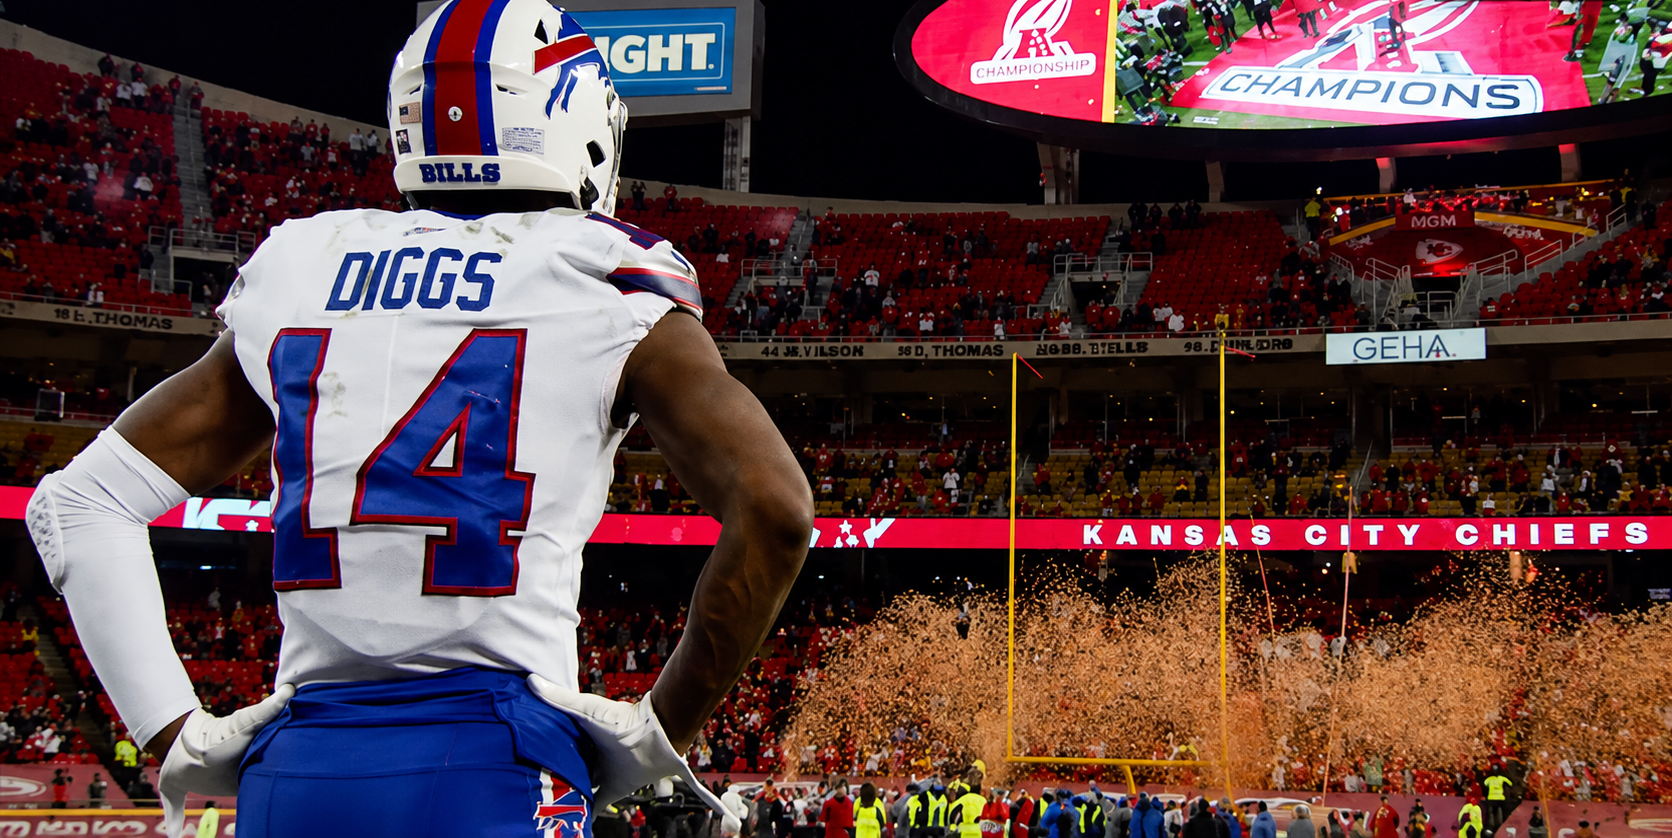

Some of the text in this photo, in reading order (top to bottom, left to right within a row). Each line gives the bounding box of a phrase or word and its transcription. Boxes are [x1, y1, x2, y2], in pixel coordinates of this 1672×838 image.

[595, 33, 716, 74] IGHT
[976, 59, 1090, 79] CHAMPIONSHIP
[1219, 73, 1520, 110] CHAMPIONS
[419, 162, 501, 184] BILLS
[1411, 215, 1457, 228] MGM
[325, 246, 502, 312] DIGGS
[267, 328, 536, 597] 14
[1083, 522, 1648, 546] KANSAS CITY CHIEFS
